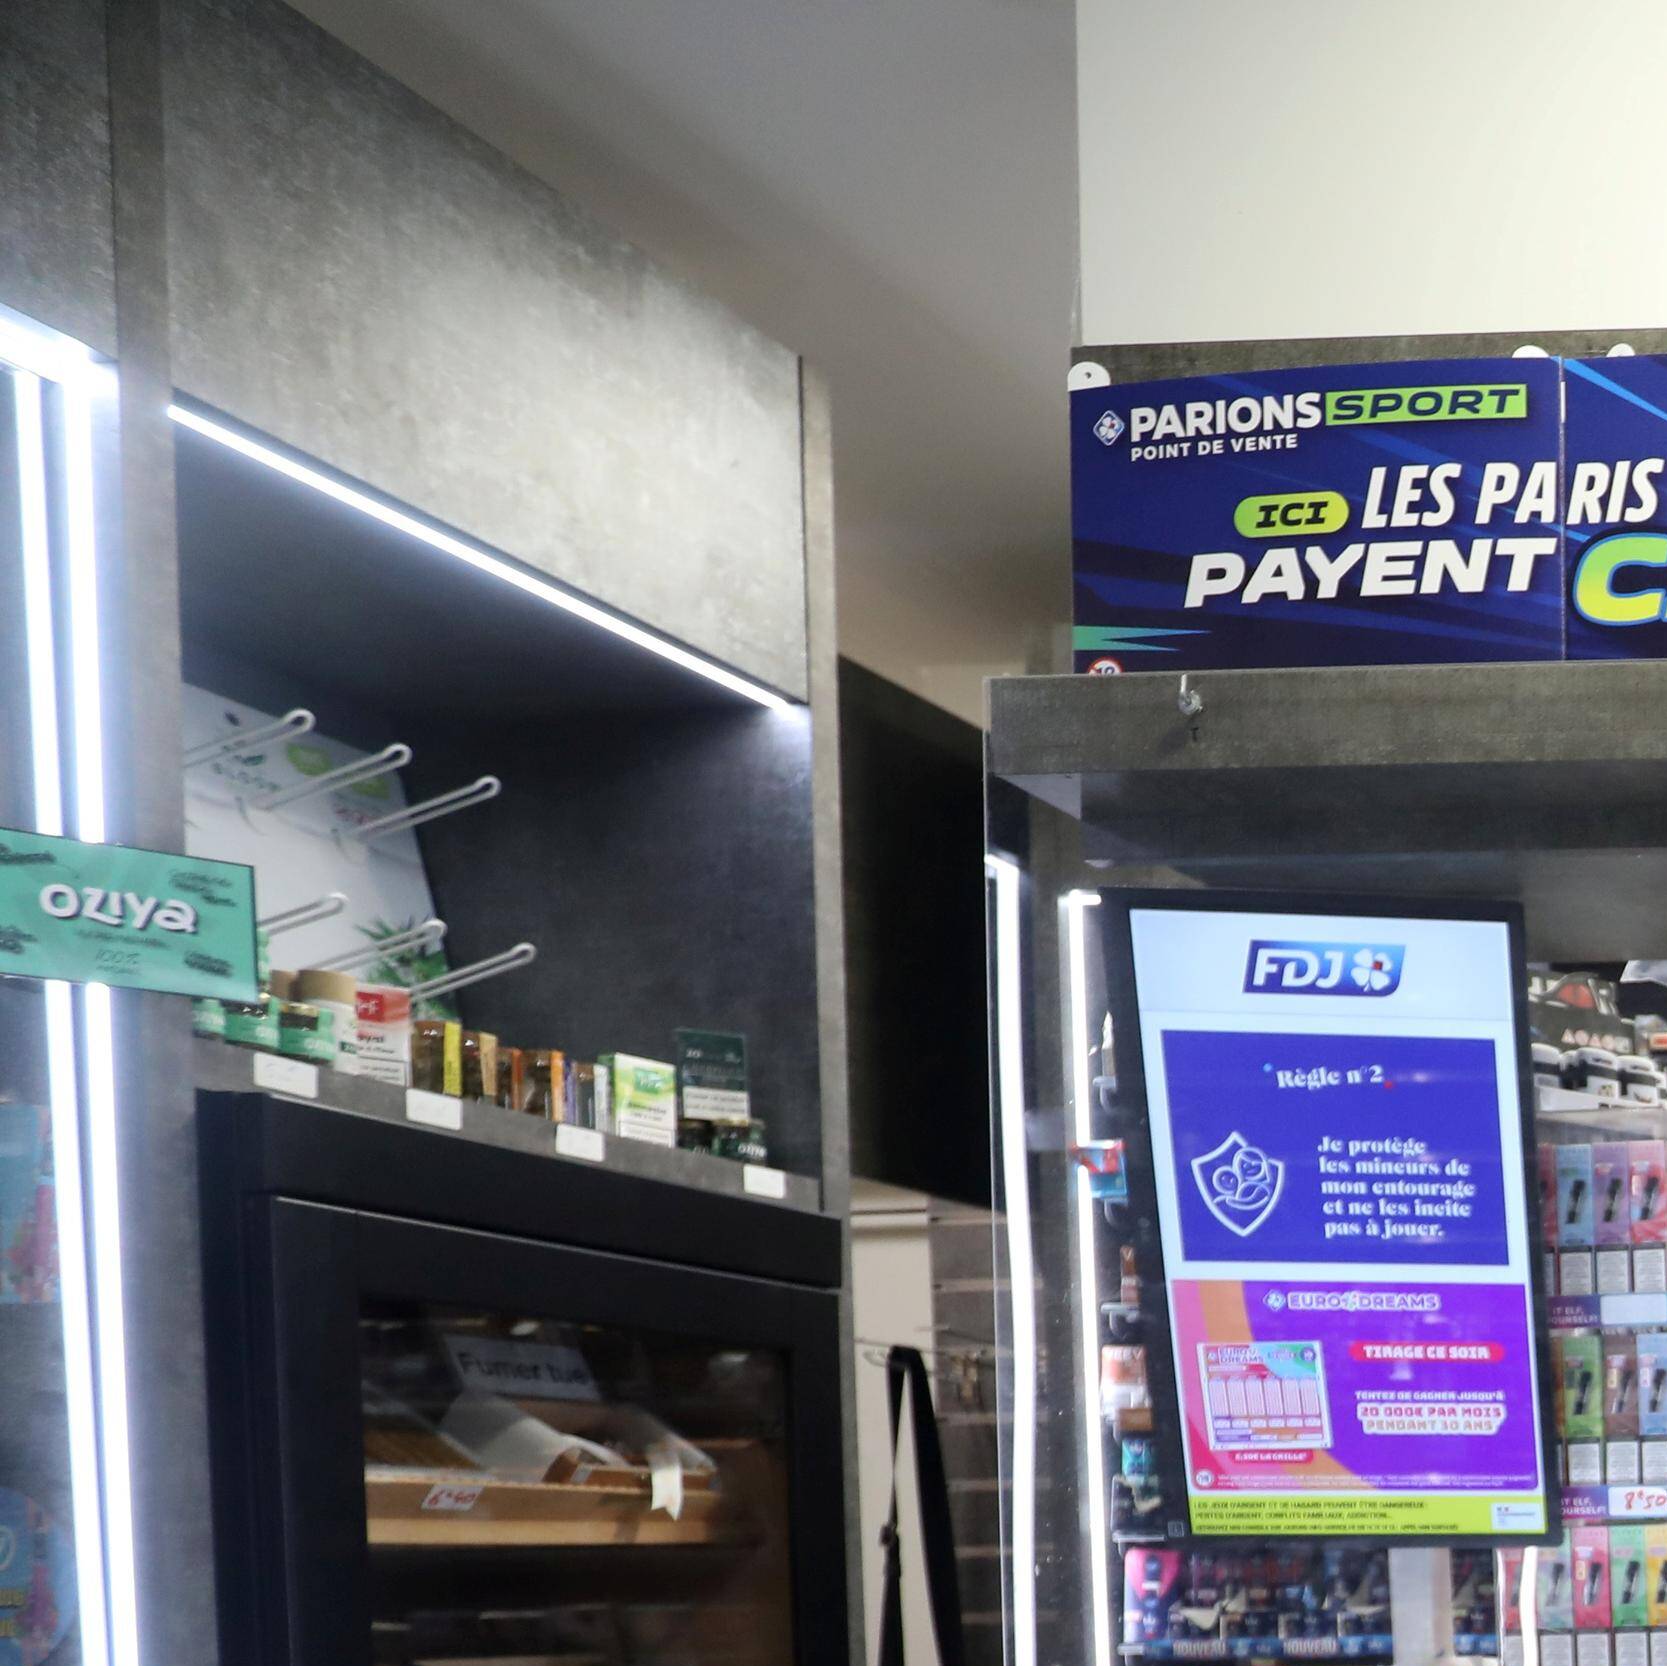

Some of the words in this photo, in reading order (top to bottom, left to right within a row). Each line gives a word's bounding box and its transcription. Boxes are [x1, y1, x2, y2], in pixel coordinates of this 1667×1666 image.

[1130, 393, 1321, 442] PARIONS
[1332, 388, 1520, 421] SPORT
[1131, 442, 1189, 461] POINT
[1198, 439, 1225, 455] DE
[1232, 434, 1298, 452] VENTE
[1256, 501, 1328, 528] ICI
[1361, 463, 1462, 529] LES
[1474, 458, 1663, 526] PARIS
[1184, 537, 1557, 609] PAYENT
[1252, 947, 1345, 989] FDJ
[1275, 1066, 1340, 1090] Règle
[1317, 1136, 1342, 1153] Je
[1349, 1136, 1427, 1157] protège
[1319, 1156, 1349, 1174] les
[1355, 1157, 1440, 1175] mineurs
[1444, 1159, 1472, 1176] de
[1320, 1179, 1367, 1196] mon
[1371, 1180, 1476, 1200] entourage
[1322, 1200, 1345, 1217] et
[1348, 1201, 1373, 1217] ne
[1379, 1198, 1409, 1217] les
[1413, 1198, 1472, 1218] incite
[1324, 1220, 1362, 1239] pas
[1365, 1218, 1379, 1236] à
[1381, 1219, 1446, 1240] jouer.
[1363, 1345, 1424, 1360] TIRAGE
[1427, 1345, 1446, 1360] CE
[1448, 1345, 1490, 1360] SOIR
[457, 1352, 541, 1381] Fumer
[547, 1357, 592, 1384] tue
